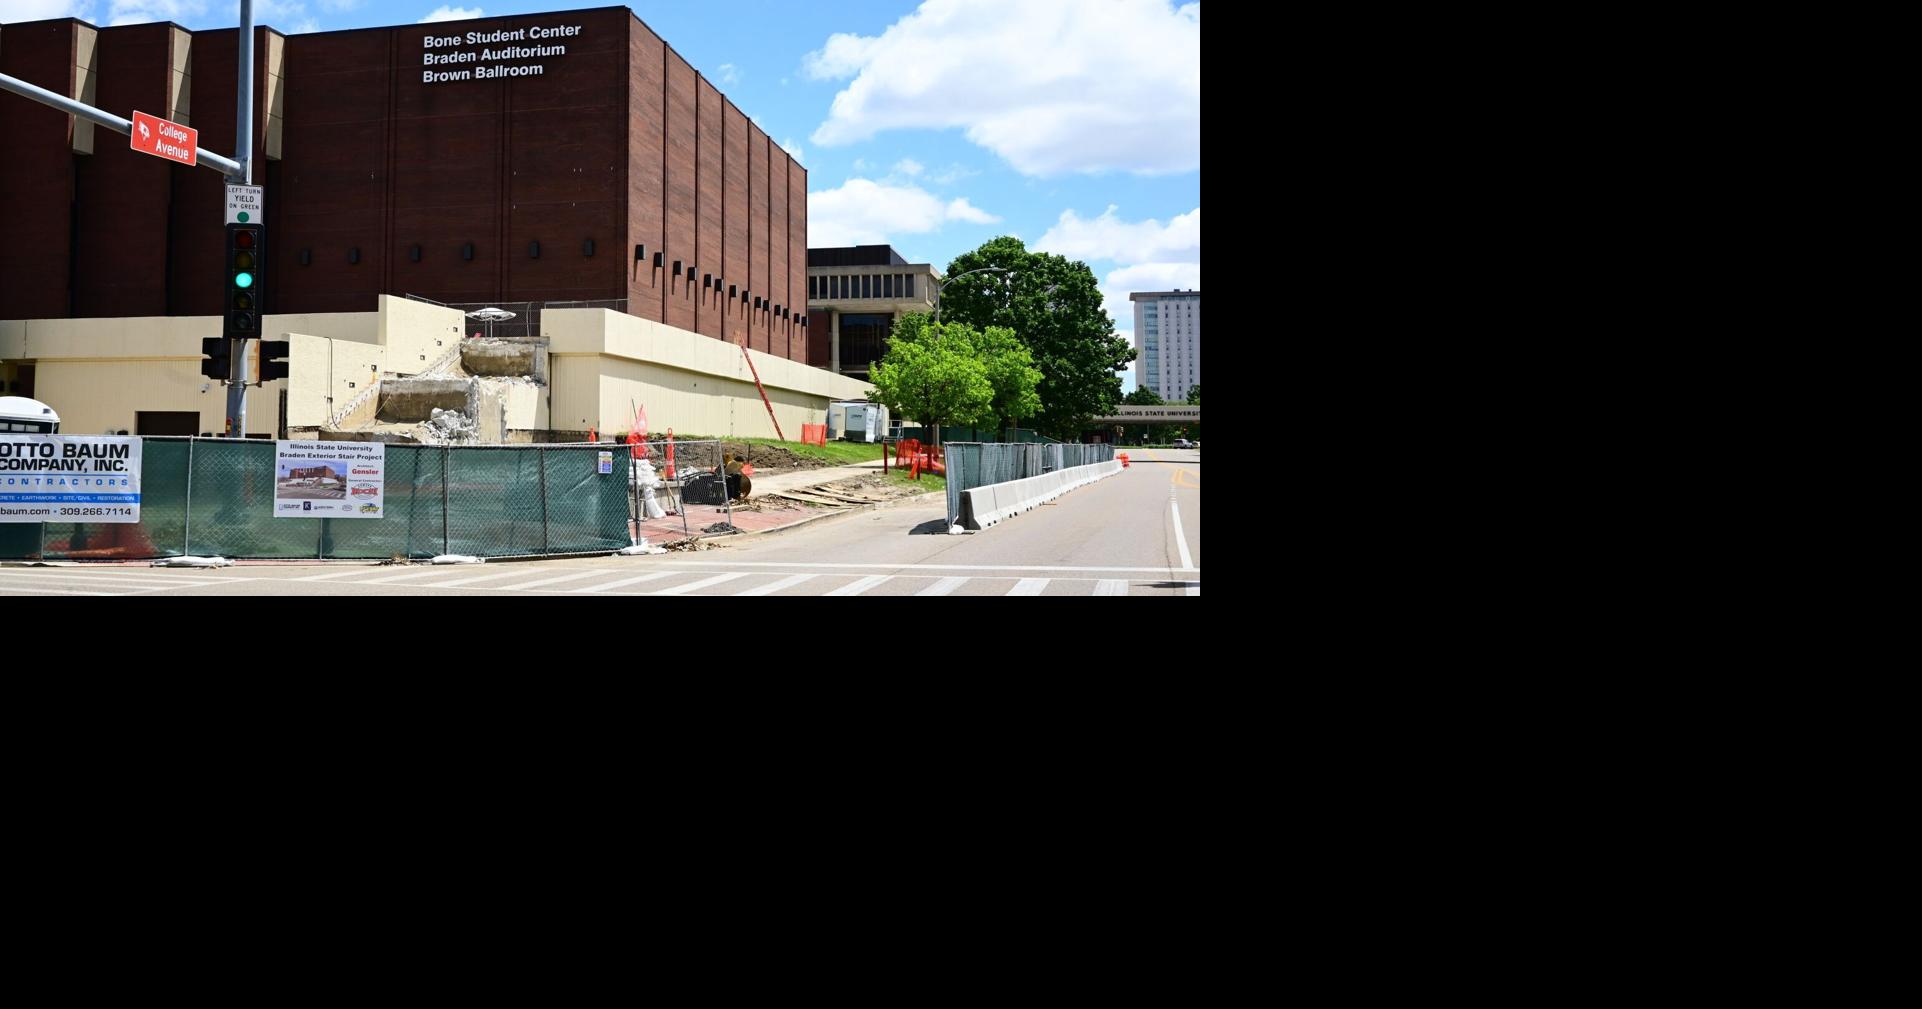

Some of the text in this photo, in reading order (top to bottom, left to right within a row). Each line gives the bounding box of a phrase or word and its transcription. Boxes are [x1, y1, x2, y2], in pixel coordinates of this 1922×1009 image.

[423, 25, 582, 48] Bone Student Center
[423, 44, 566, 66] Braden Auditorium
[422, 64, 543, 83] Brown Ballroom
[158, 122, 188, 144] College
[155, 138, 189, 160] Avenue
[234, 194, 255, 203] YIELD
[0, 442, 129, 459] OTTO BAUM
[94, 460, 128, 472] INC.
[0, 478, 128, 486] ONTRACTORS
[60, 507, 131, 516] 309.266.7114
